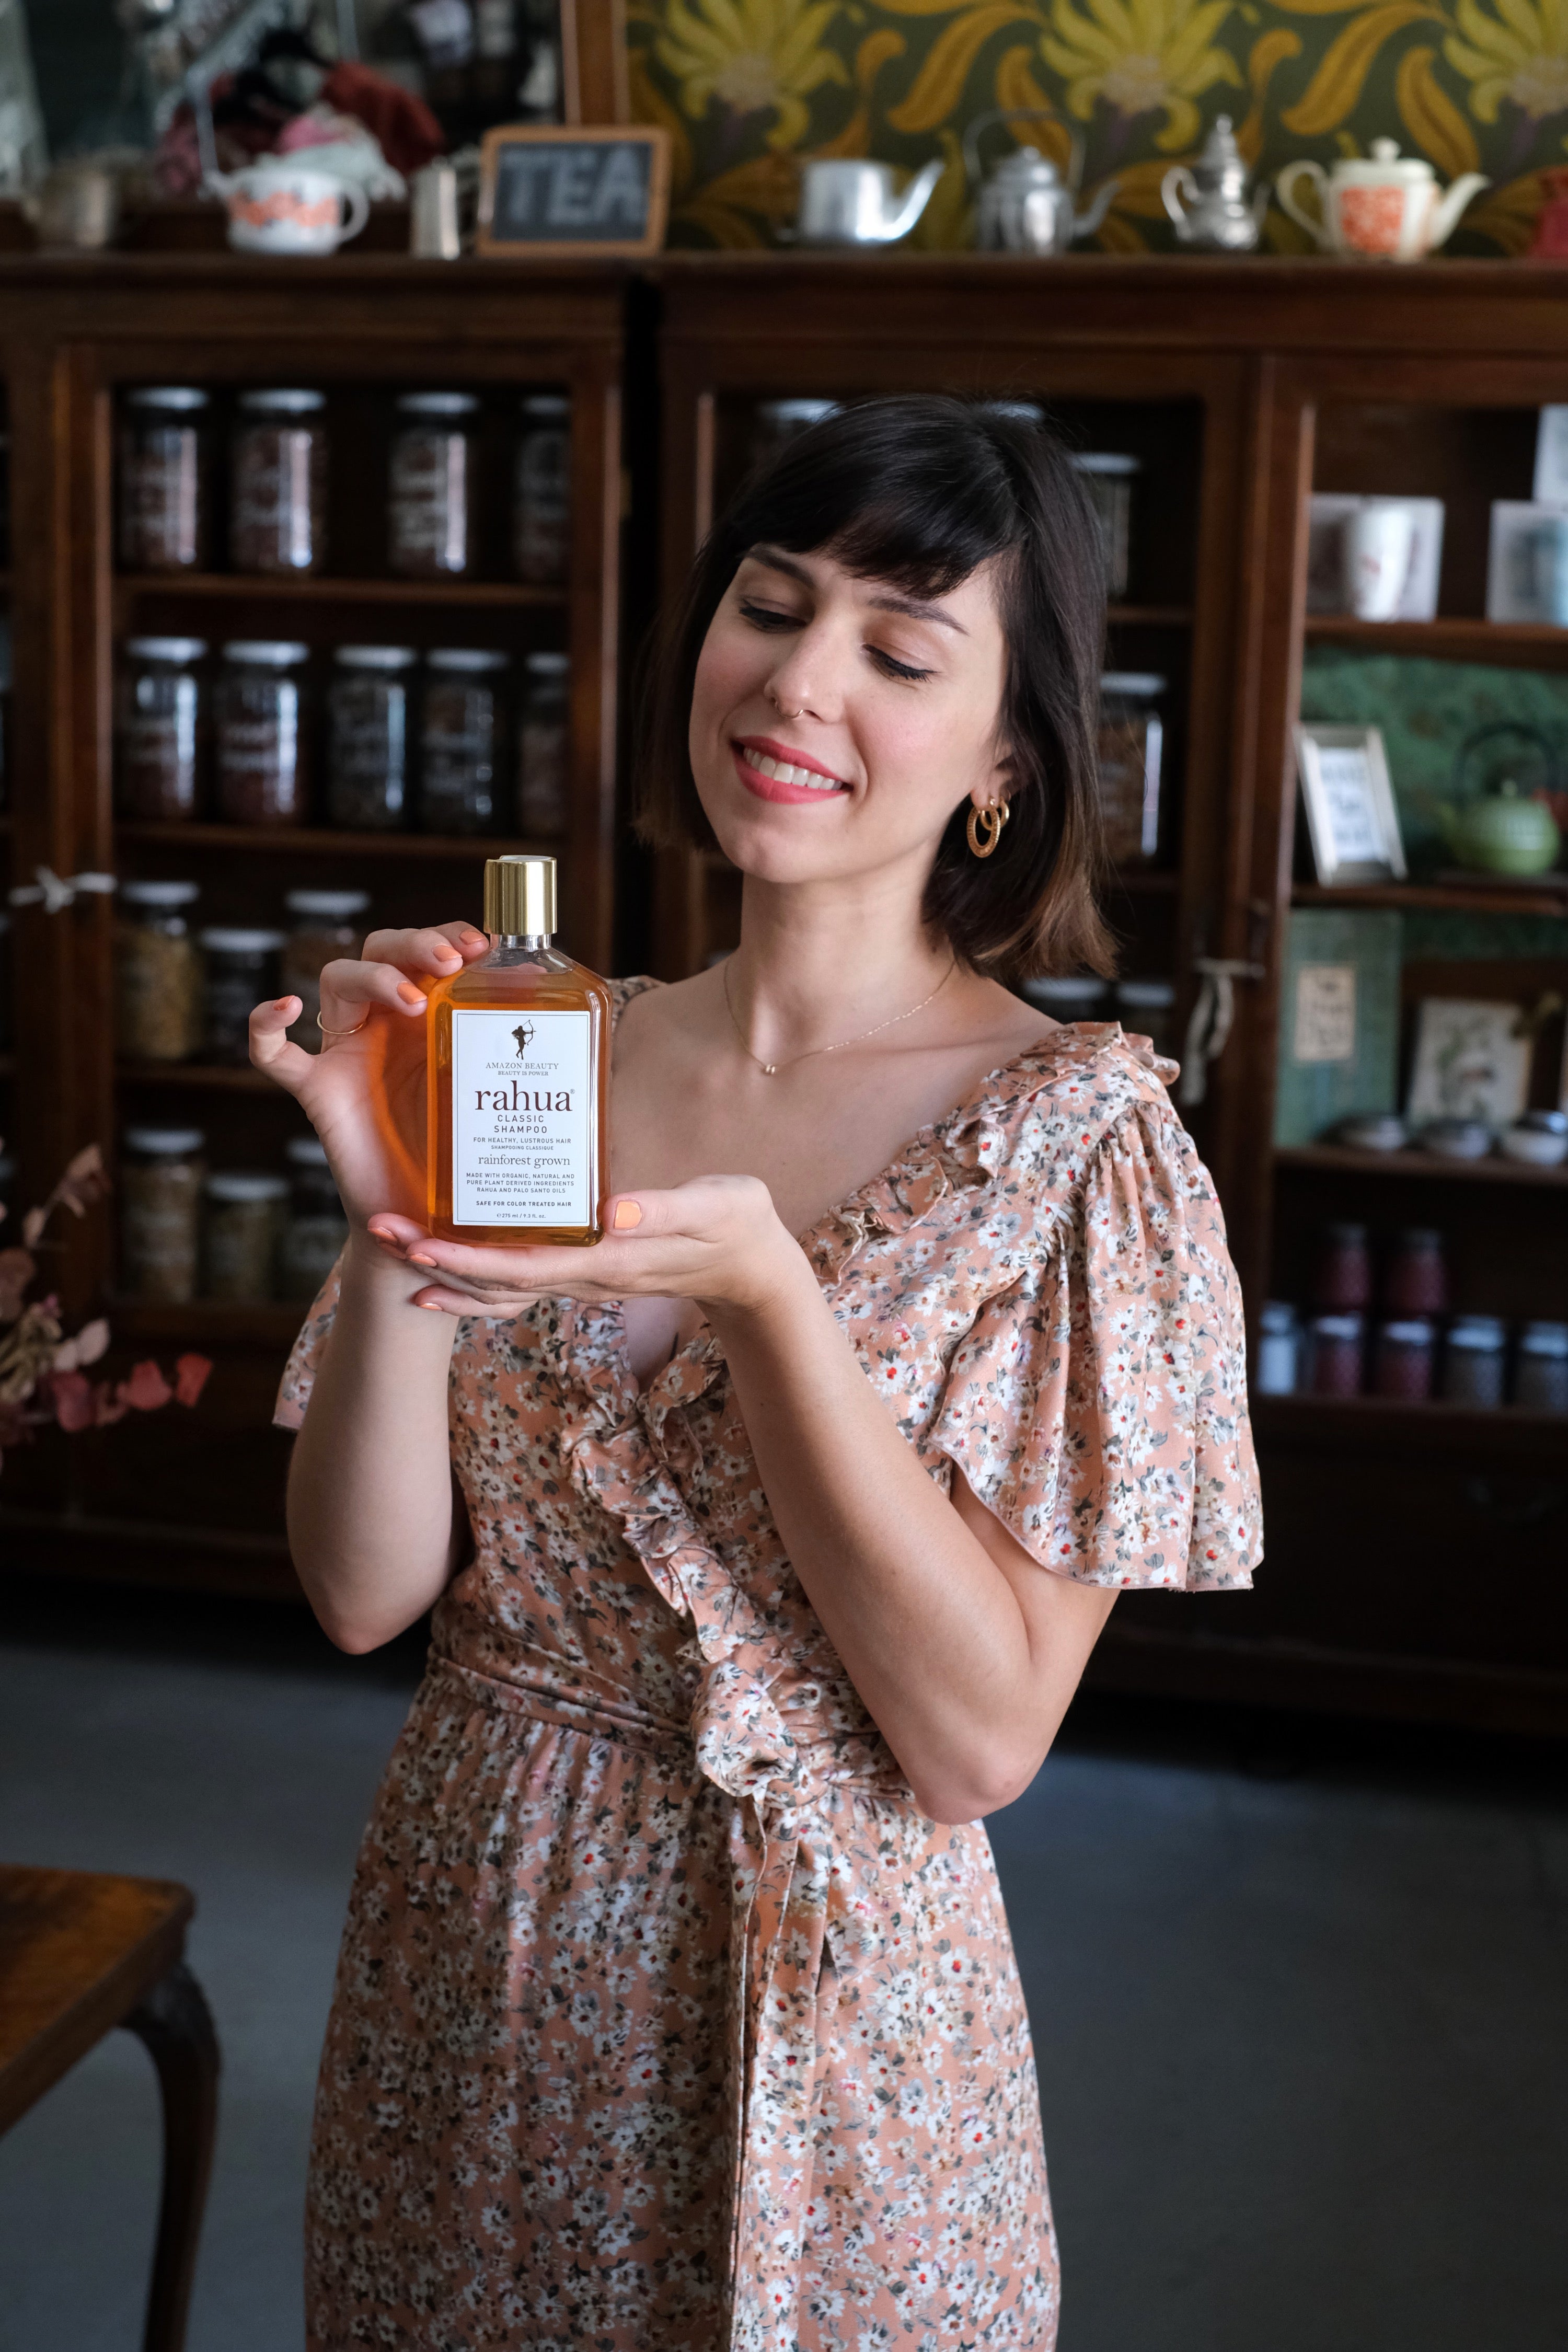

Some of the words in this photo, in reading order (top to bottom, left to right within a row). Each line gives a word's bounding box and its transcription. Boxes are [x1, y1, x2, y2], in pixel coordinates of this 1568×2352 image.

[503, 147, 645, 225] TEA
[497, 1114, 544, 1123] CLASSIC
[494, 1125, 547, 1134] SHAMPOO
[478, 1154, 531, 1166] rainforest
[534, 1158, 570, 1169] grown
